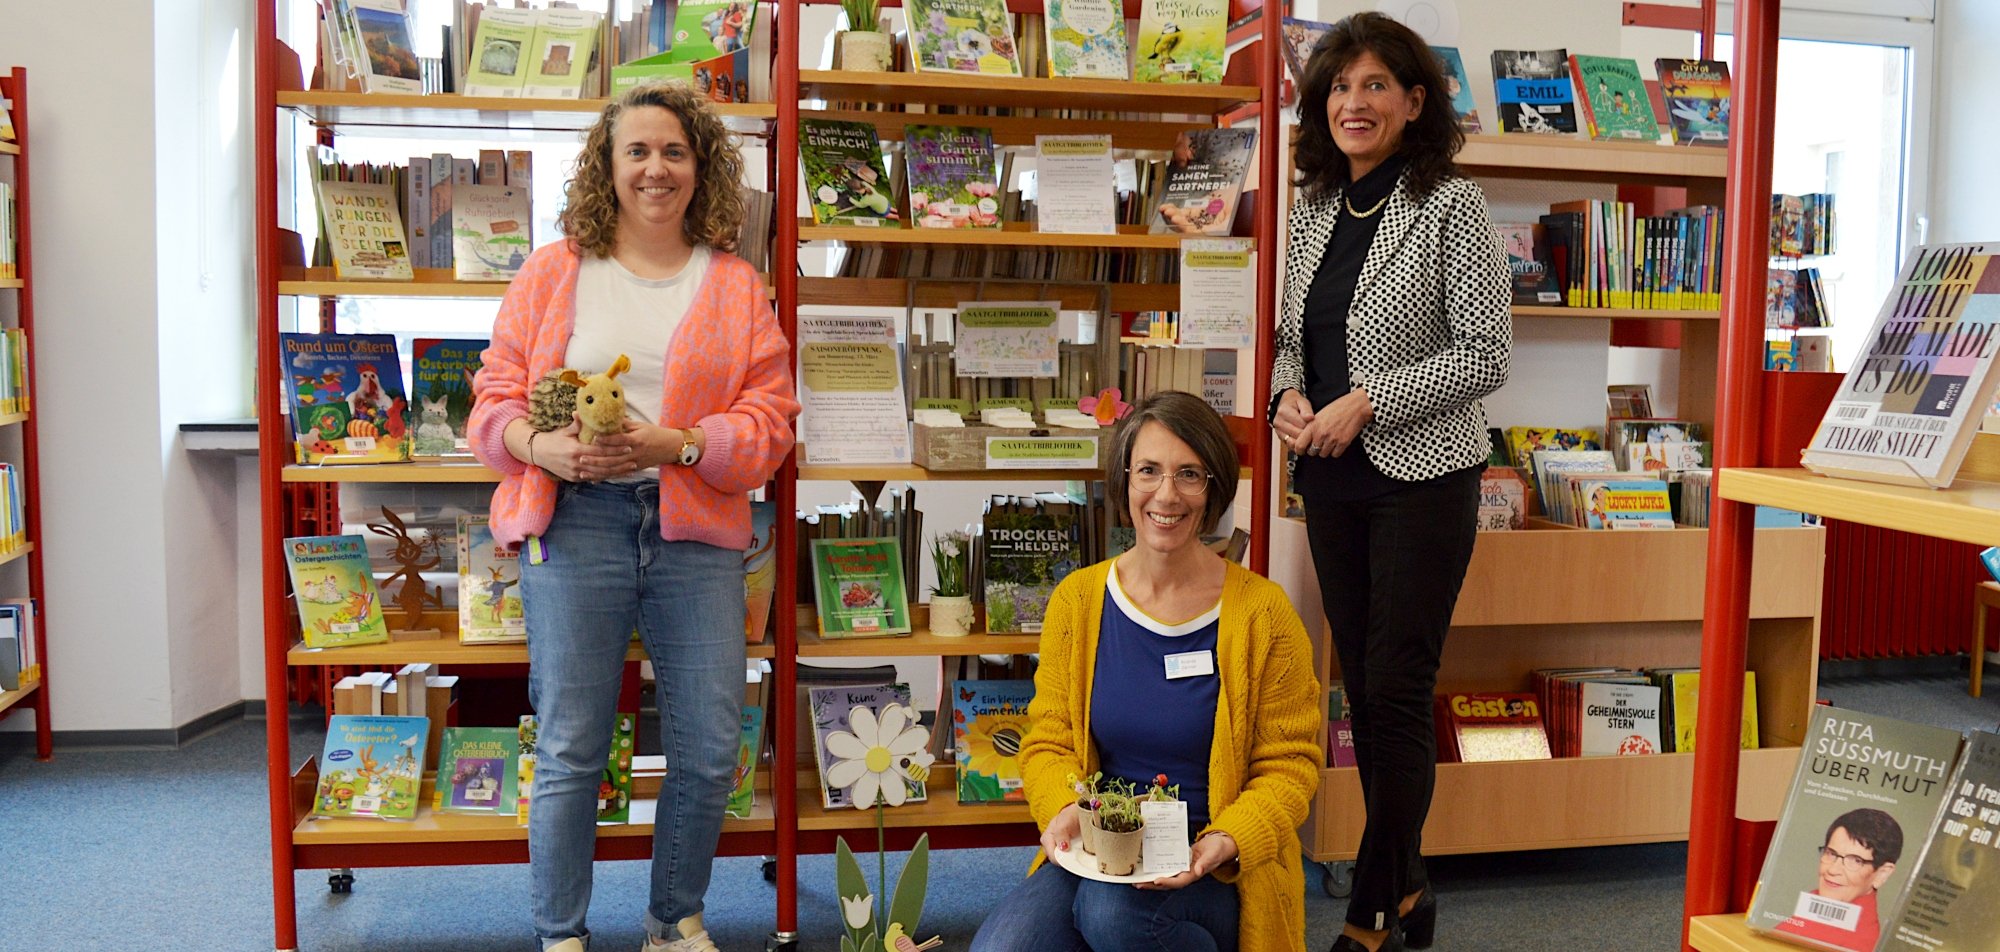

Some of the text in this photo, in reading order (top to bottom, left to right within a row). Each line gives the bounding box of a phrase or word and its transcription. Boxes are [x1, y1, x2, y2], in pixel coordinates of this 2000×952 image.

[1516, 86, 1564, 99] EMIL
[805, 125, 866, 137] Es geht auch
[940, 132, 974, 143] Mein
[808, 135, 870, 149] EINFACH!
[940, 143, 988, 155] Garten
[1168, 181, 1230, 192] GÄRTNEREI
[335, 209, 393, 223] RUNGEN
[464, 208, 515, 218] Ruhrgebiet
[339, 222, 396, 238] FÜR DIE
[342, 239, 383, 251] SEELE
[1511, 260, 1543, 273] RYPTO
[1907, 246, 1983, 281] LOOK
[1892, 284, 1972, 318] WHAT
[286, 339, 394, 353] Rund um Ostern
[1870, 321, 2000, 358] SHE MADE
[441, 348, 463, 359] Das
[419, 371, 460, 381] für die
[1210, 378, 1233, 386] COMEY
[1853, 358, 1930, 395] US DO
[1824, 426, 1942, 459] TAYLOR SWIFT
[1480, 494, 1508, 506] LMES
[1608, 496, 1665, 510] LUCKY LUKE
[990, 529, 1069, 541] TROCKEN
[1014, 542, 1070, 552] HELDEN
[295, 553, 362, 564] Ostergeschichten
[847, 692, 877, 704] Keine
[982, 695, 1031, 704] Ein kleines
[972, 705, 1028, 716] Samenko
[1587, 704, 1656, 719] GEHEIMNISVOLLE
[1608, 718, 1635, 729] STERN
[1823, 717, 1874, 742] RITA
[462, 741, 502, 749] DAS KLEINE
[1816, 737, 1947, 778] SÜSSMUTH
[1811, 755, 1938, 796] ÜBER MUT
[1804, 787, 1849, 801] und Loslassen
[1960, 779, 1975, 797] In
[1856, 790, 1898, 805] Durchhalten
[1952, 797, 1977, 817] das
[1943, 819, 1992, 845] nur ein
